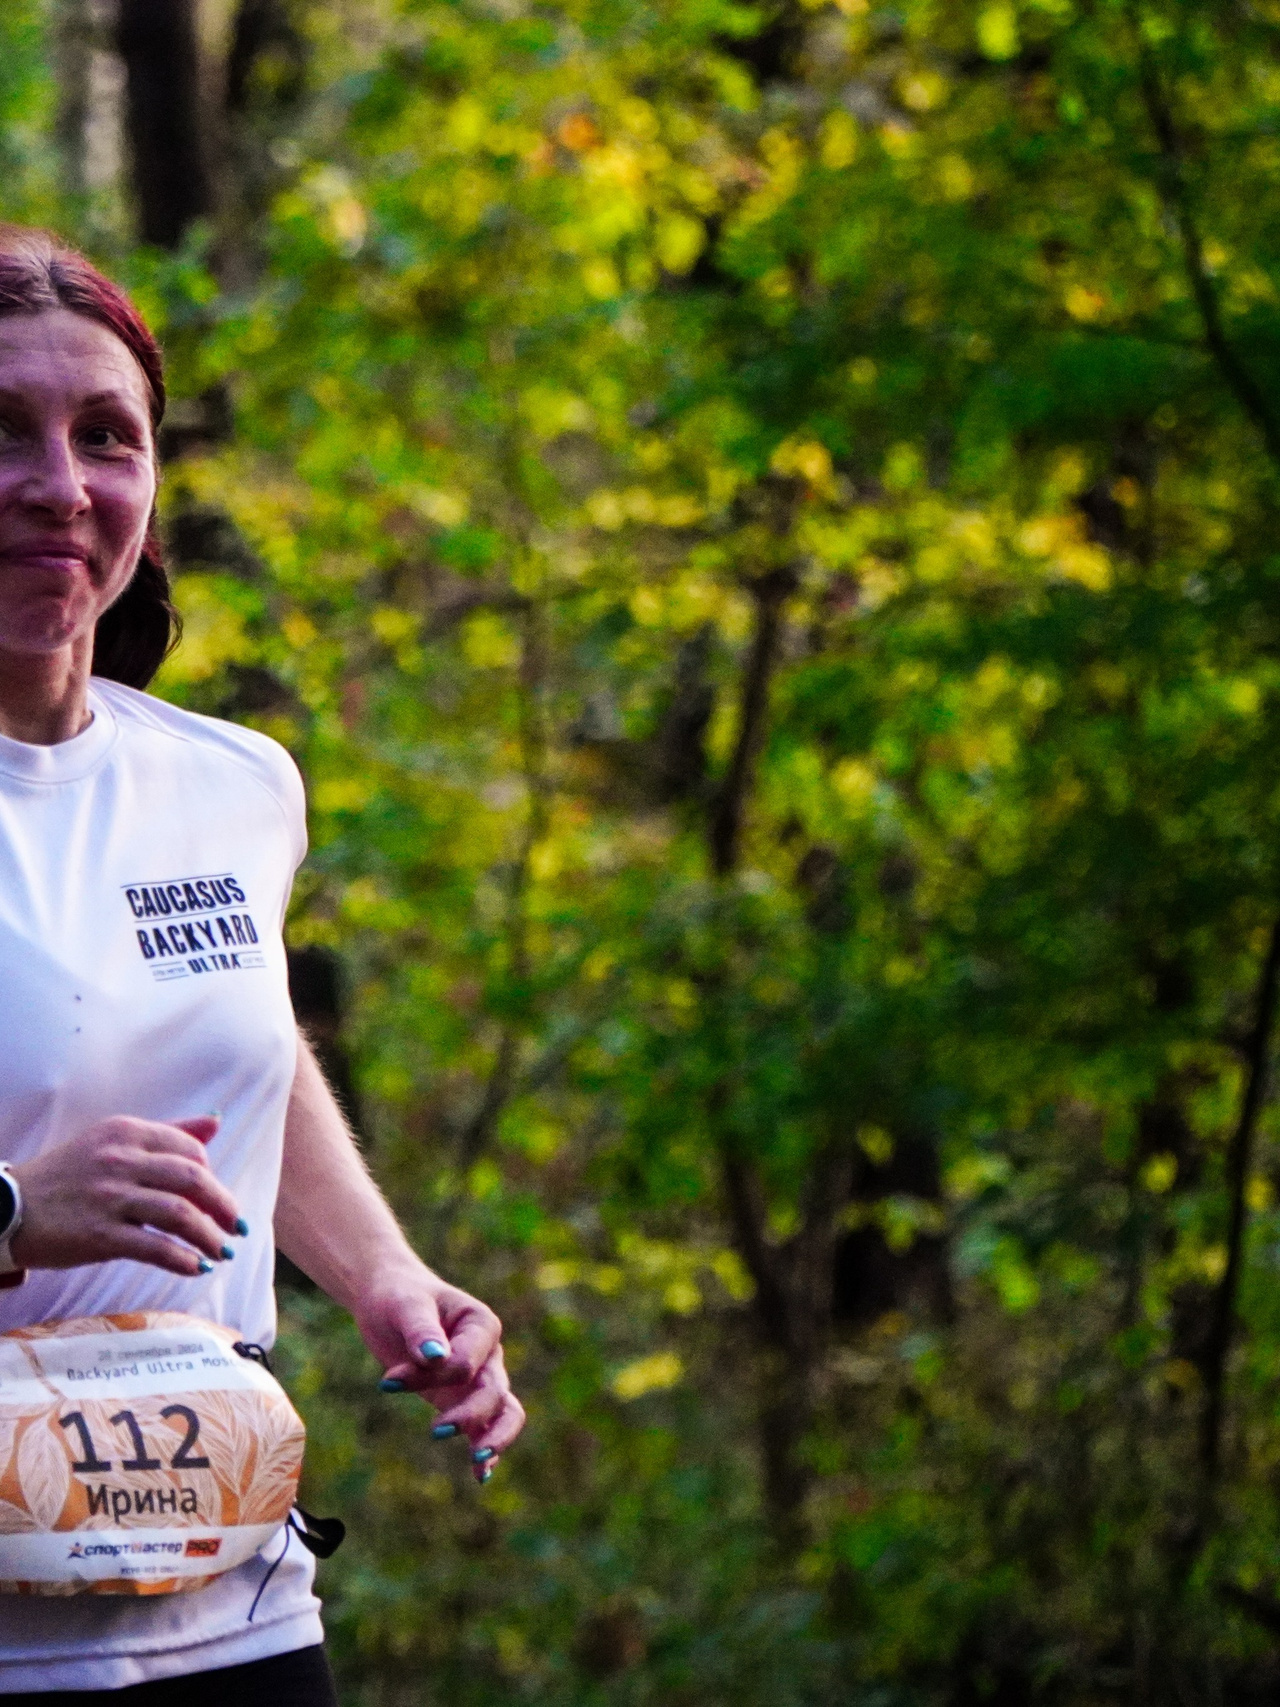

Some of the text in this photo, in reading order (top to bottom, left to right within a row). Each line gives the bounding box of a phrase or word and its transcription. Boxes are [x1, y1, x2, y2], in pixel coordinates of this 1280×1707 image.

[125, 877, 246, 918] CAUCASUS
[136, 914, 259, 960] BACKYARD
[187, 953, 242, 974] ULTRA
[67, 1364, 139, 1381] Backyard
[147, 1361, 194, 1374] Ultra
[58, 1404, 210, 1472] 112
[86, 1484, 198, 1524] Ирина
